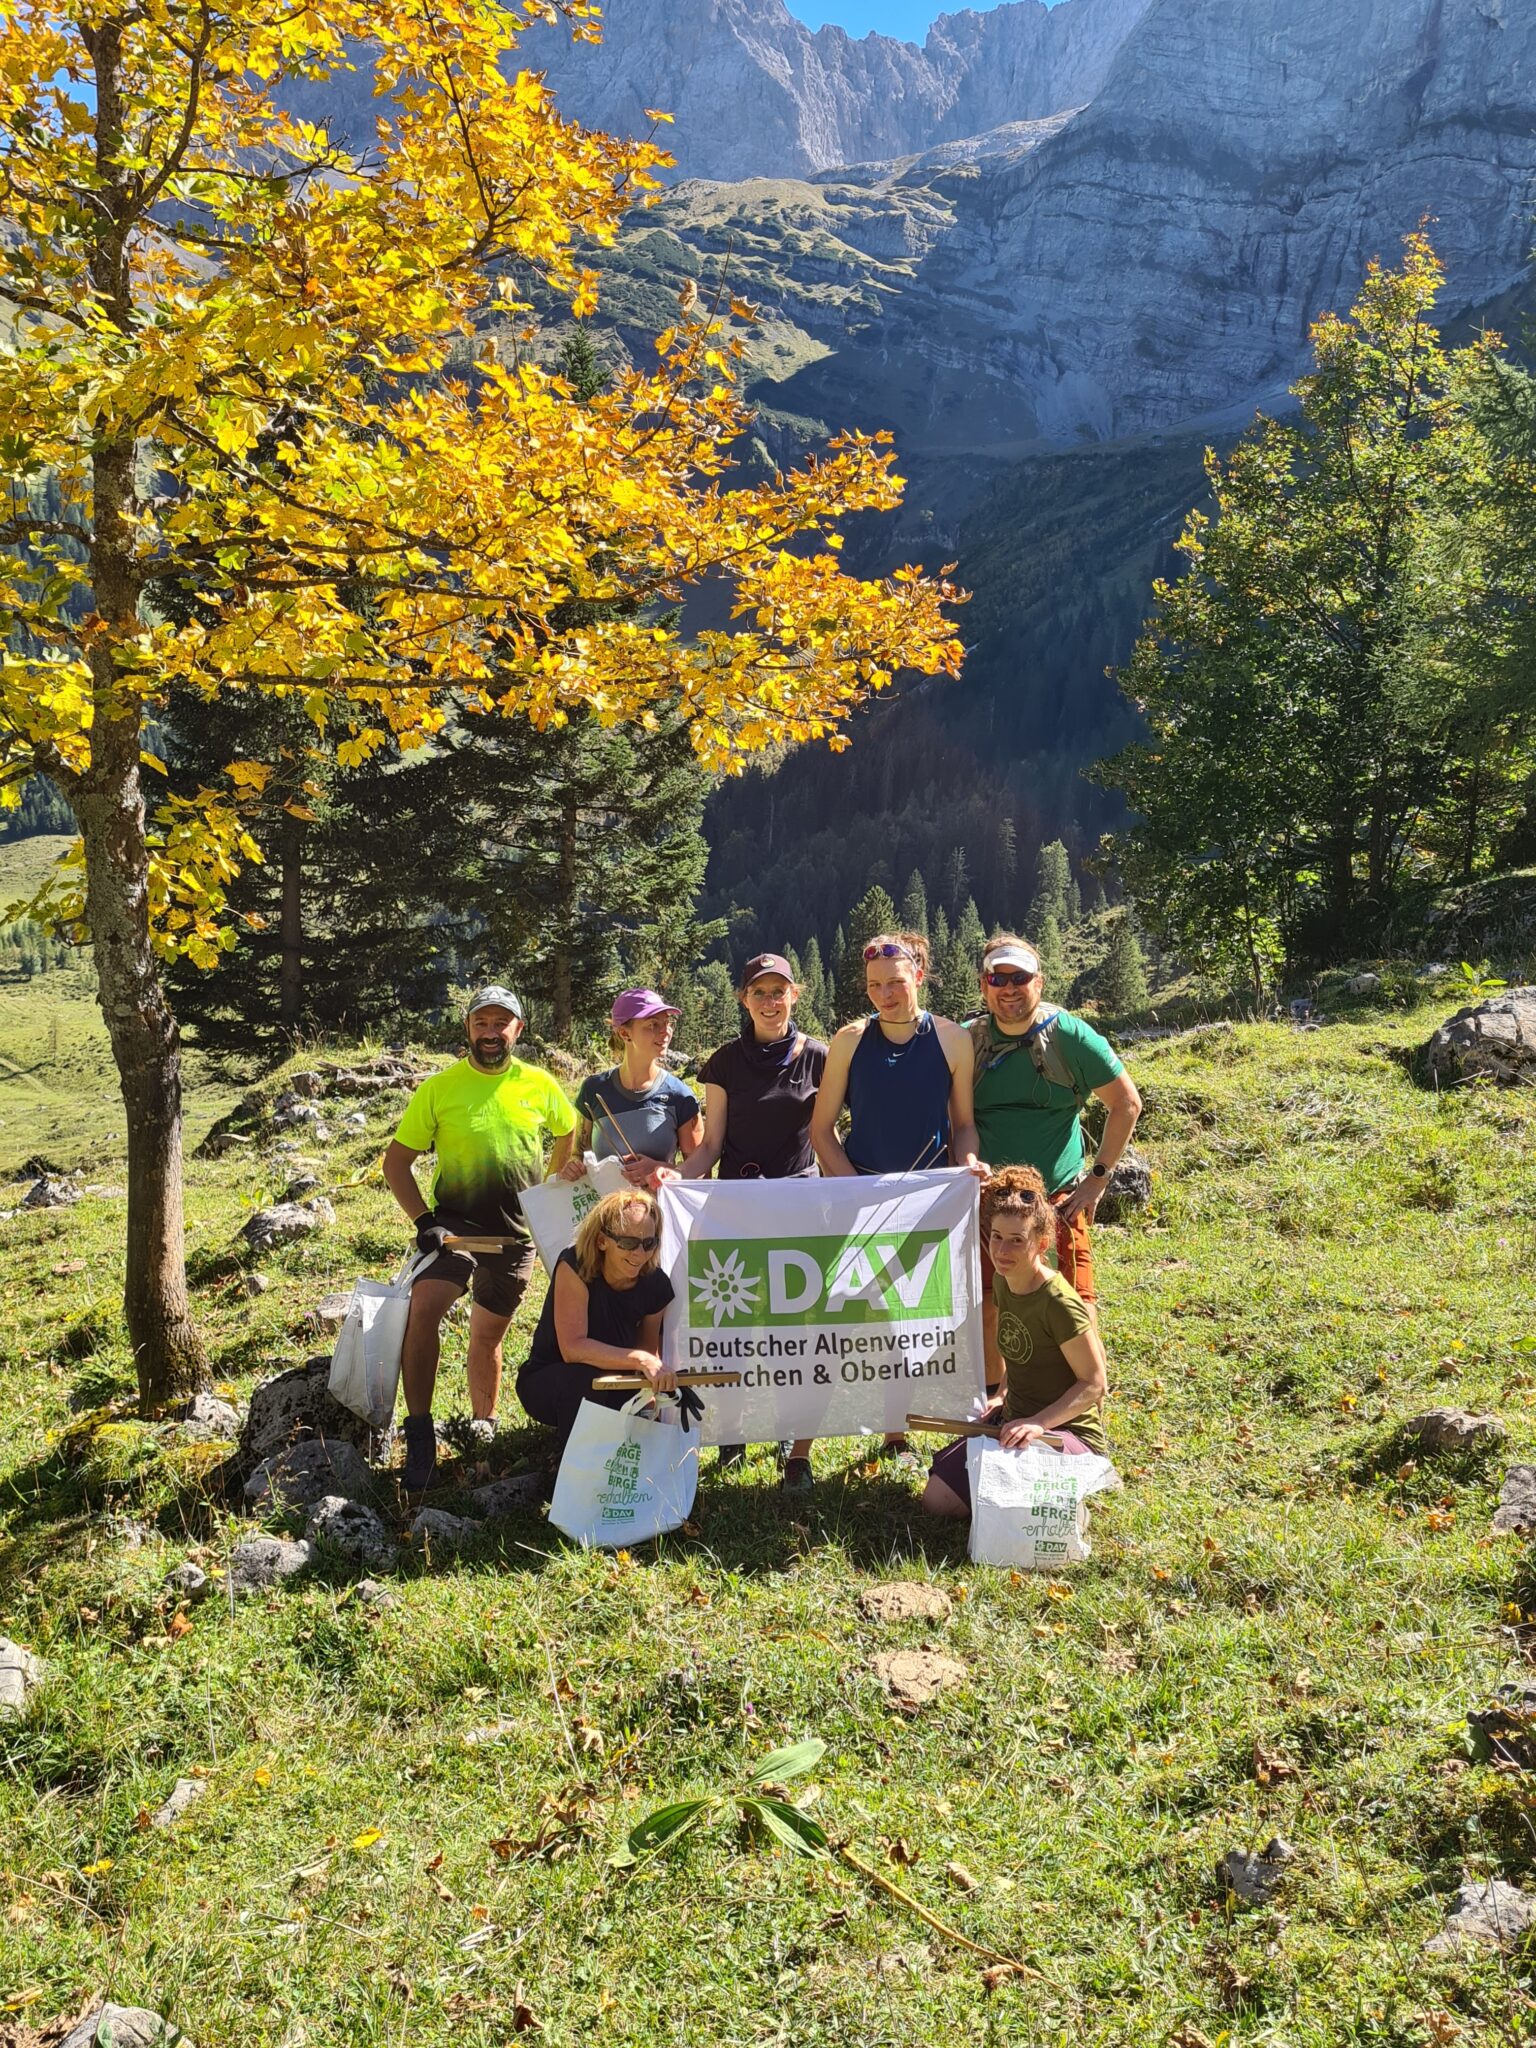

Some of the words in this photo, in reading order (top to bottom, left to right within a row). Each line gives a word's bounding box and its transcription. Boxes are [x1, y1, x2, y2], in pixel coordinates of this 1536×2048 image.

[767, 1242, 940, 1315] DAV
[689, 1335, 808, 1359] Deutscher
[814, 1327, 956, 1359] Alpenverein
[813, 1364, 832, 1385] &
[841, 1352, 957, 1383] Oberland
[1031, 1506, 1077, 1521] BERGE
[1046, 1542, 1066, 1551] DAV
